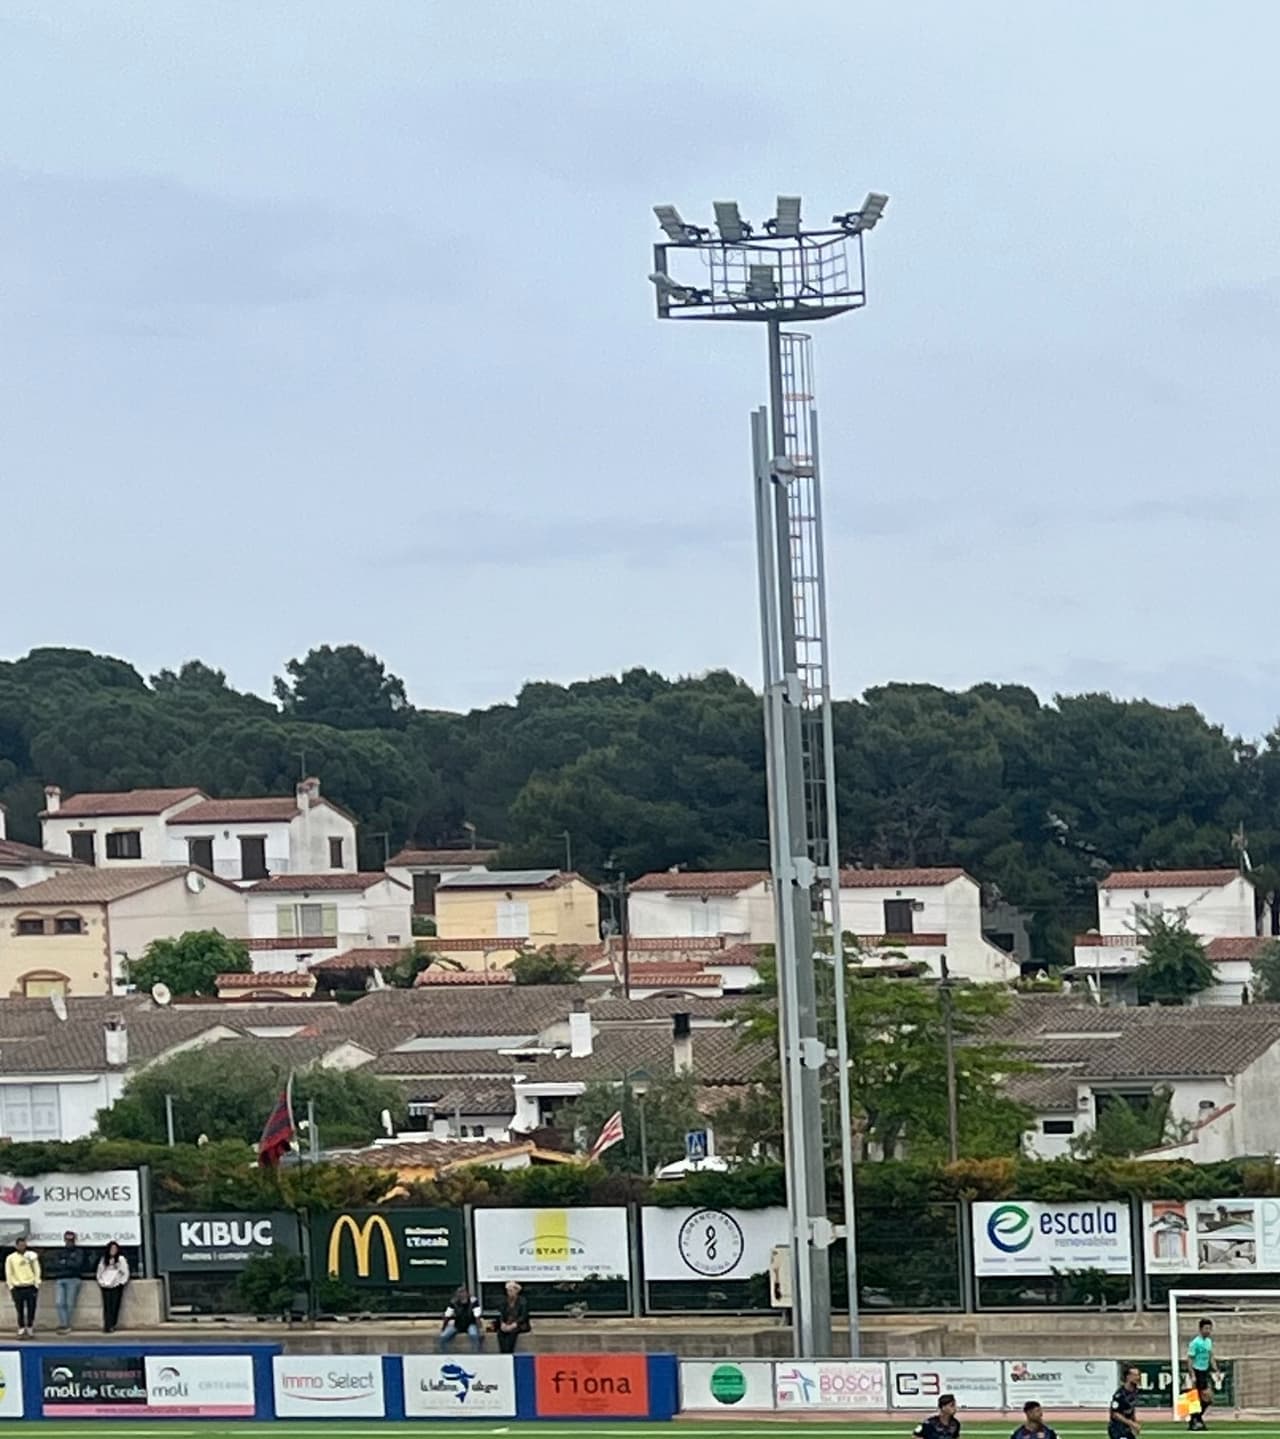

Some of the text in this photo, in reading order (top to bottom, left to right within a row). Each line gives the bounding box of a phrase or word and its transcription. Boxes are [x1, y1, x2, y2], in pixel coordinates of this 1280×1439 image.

[43, 1186, 132, 1201] K3HOMES
[1040, 1206, 1117, 1235] escala
[180, 1220, 273, 1247] KIBUC
[327, 1371, 375, 1389] Select
[551, 1371, 632, 1394] fiona
[819, 1375, 884, 1392] BOSCH
[82, 1385, 98, 1398] de
